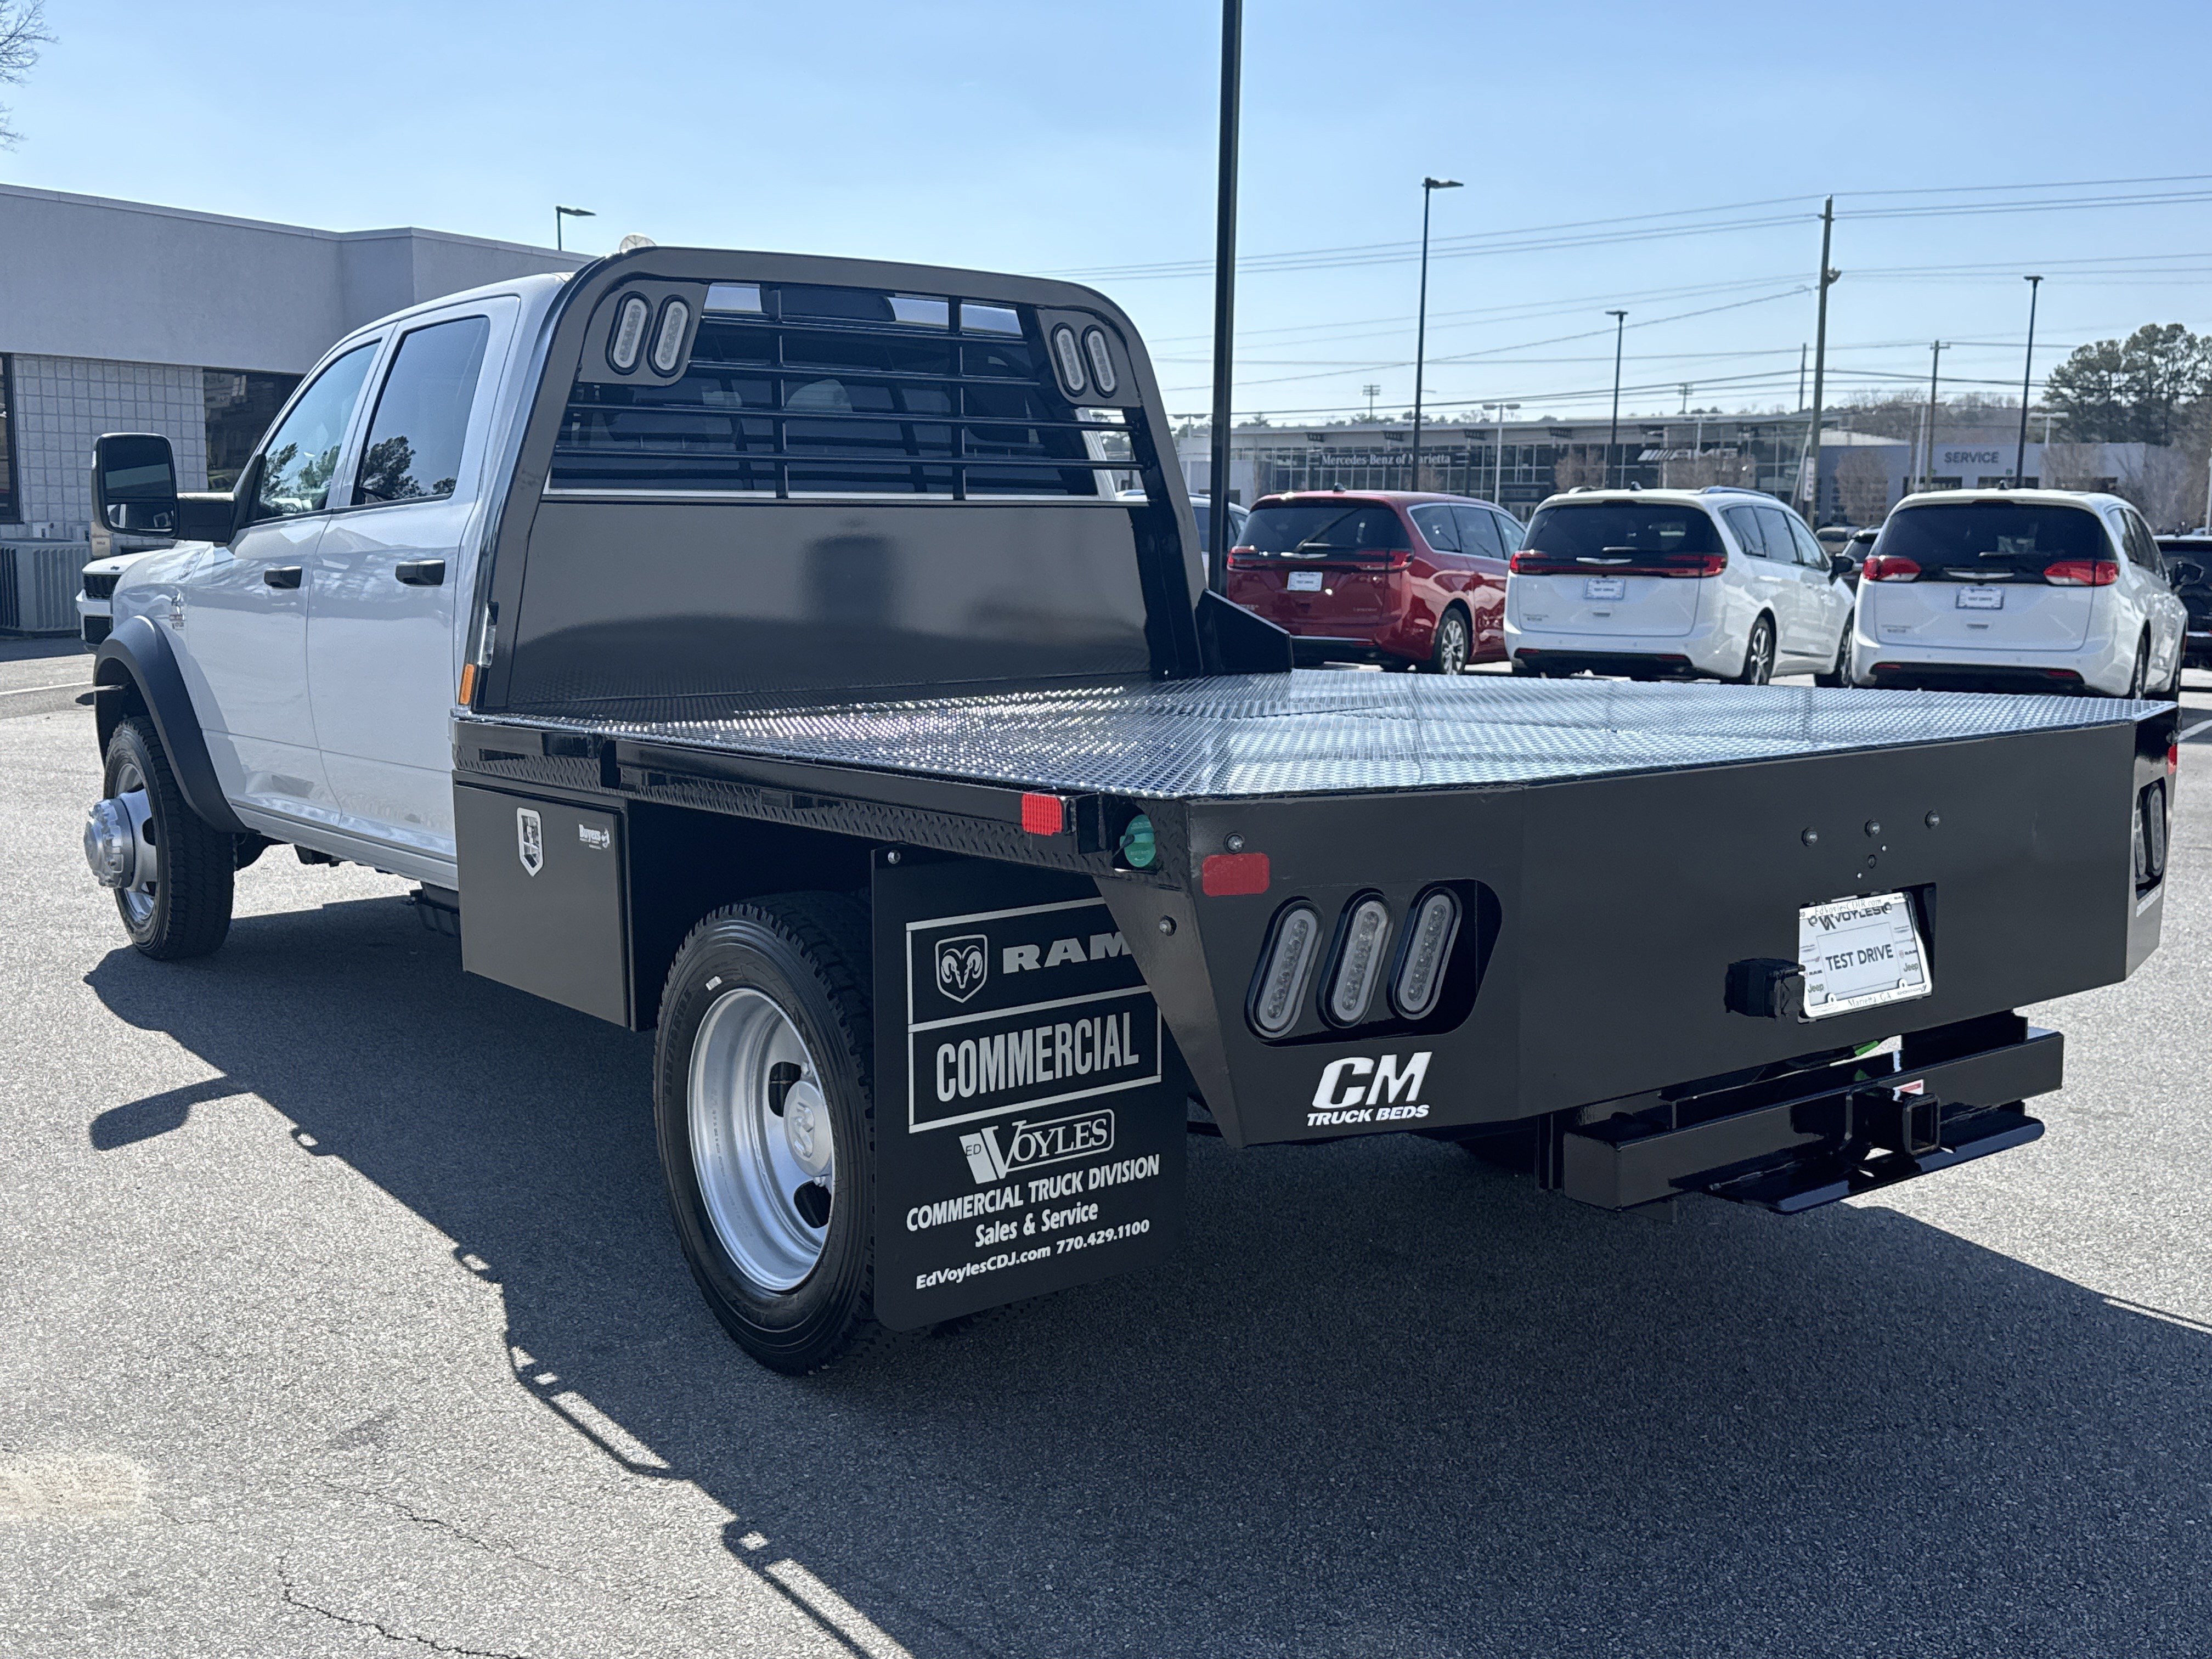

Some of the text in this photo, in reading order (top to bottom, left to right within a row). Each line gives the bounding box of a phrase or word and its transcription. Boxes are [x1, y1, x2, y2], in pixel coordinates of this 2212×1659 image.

[1396, 453, 1407, 465] of
[1944, 451, 1999, 463] SERVICE
[1003, 931, 1132, 974] RAM
[1825, 944, 1894, 971] TEST DRIVE
[1903, 962, 1919, 972] Jeep
[1807, 983, 1825, 994] Jeep
[1880, 992, 1892, 1001] GA
[936, 1012, 1139, 1102] COMMERCIAL
[1312, 1051, 1433, 1109] CM
[1307, 1104, 1430, 1126] TRUCK BEDS
[965, 1118, 1108, 1180] ED VOYLES
[906, 1154, 1160, 1232] COMMERCIAL TRUCK DIVISION
[975, 1202, 1099, 1248] Sales & Service
[916, 1219, 1150, 1290] EdVoylesCDJ.com 770.429.1100
